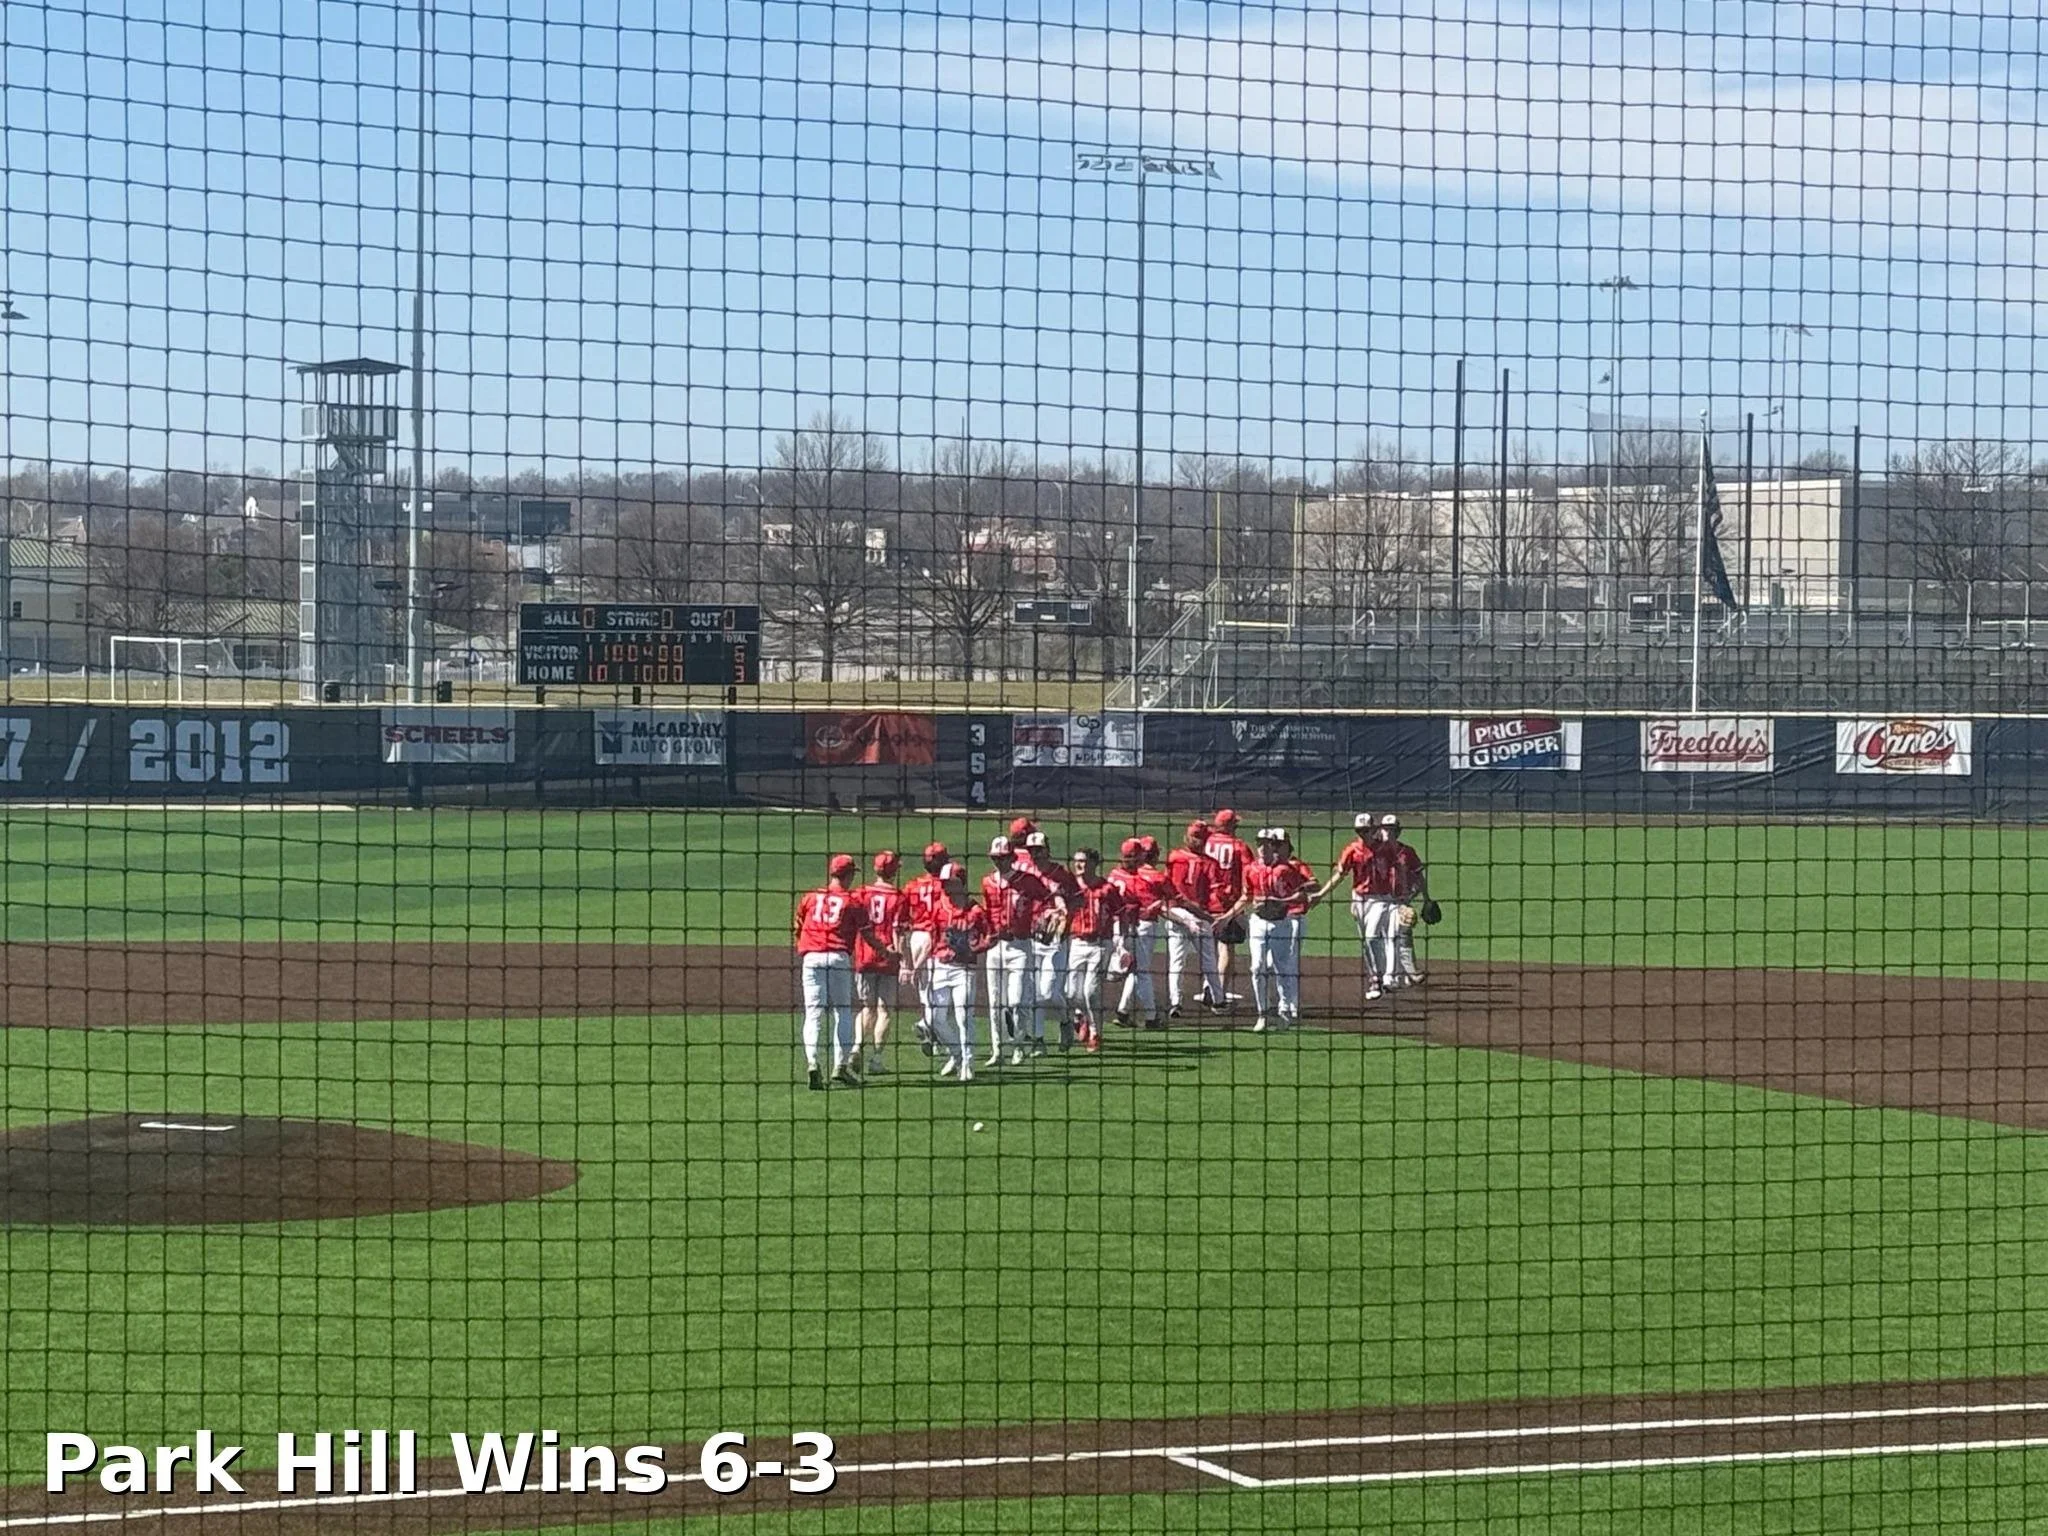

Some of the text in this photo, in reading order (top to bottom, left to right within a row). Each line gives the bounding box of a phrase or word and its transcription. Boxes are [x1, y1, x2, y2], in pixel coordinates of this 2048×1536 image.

[544, 610, 580, 625] BALL
[690, 612, 721, 627] OUT
[527, 666, 575, 680] HOME
[384, 725, 510, 744] SCHEELS
[1474, 720, 1528, 743] PRICE
[1650, 725, 1769, 757] Freddy's
[129, 718, 290, 783] 2012
[630, 739, 668, 754] AUTO
[1473, 736, 1559, 766] CHOPPER
[1205, 842, 1234, 870] 40
[812, 893, 844, 924] 13
